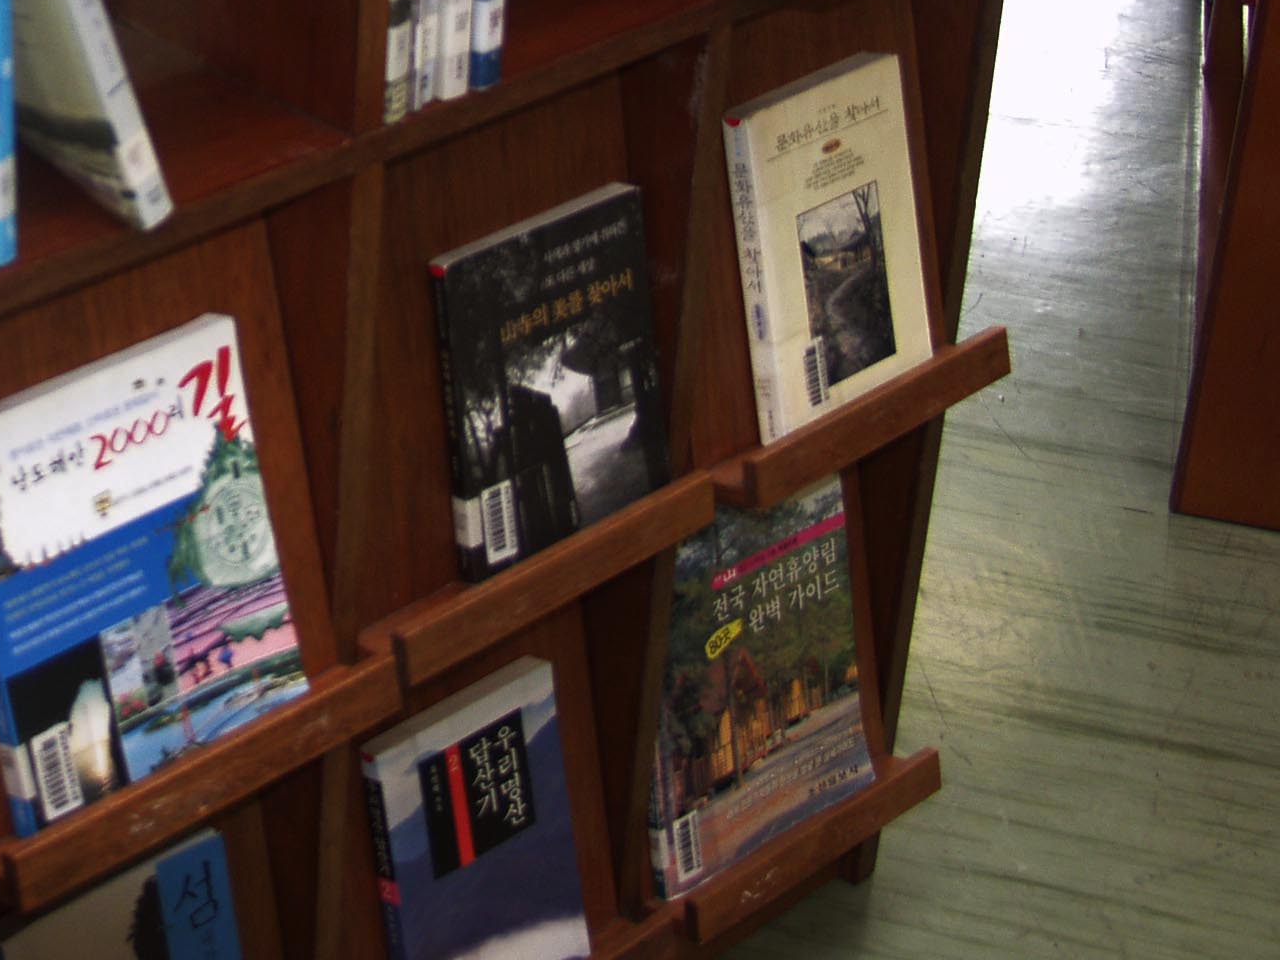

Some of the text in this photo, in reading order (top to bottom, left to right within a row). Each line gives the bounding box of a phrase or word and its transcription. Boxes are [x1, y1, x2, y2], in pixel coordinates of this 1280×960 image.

[711, 584, 747, 622] 전국
[750, 536, 838, 599] 자연휴양림
[748, 594, 782, 632] 완벽
[787, 569, 841, 610] 가이드
[468, 737, 499, 818] 답산기
[493, 724, 528, 826] 우리명산
